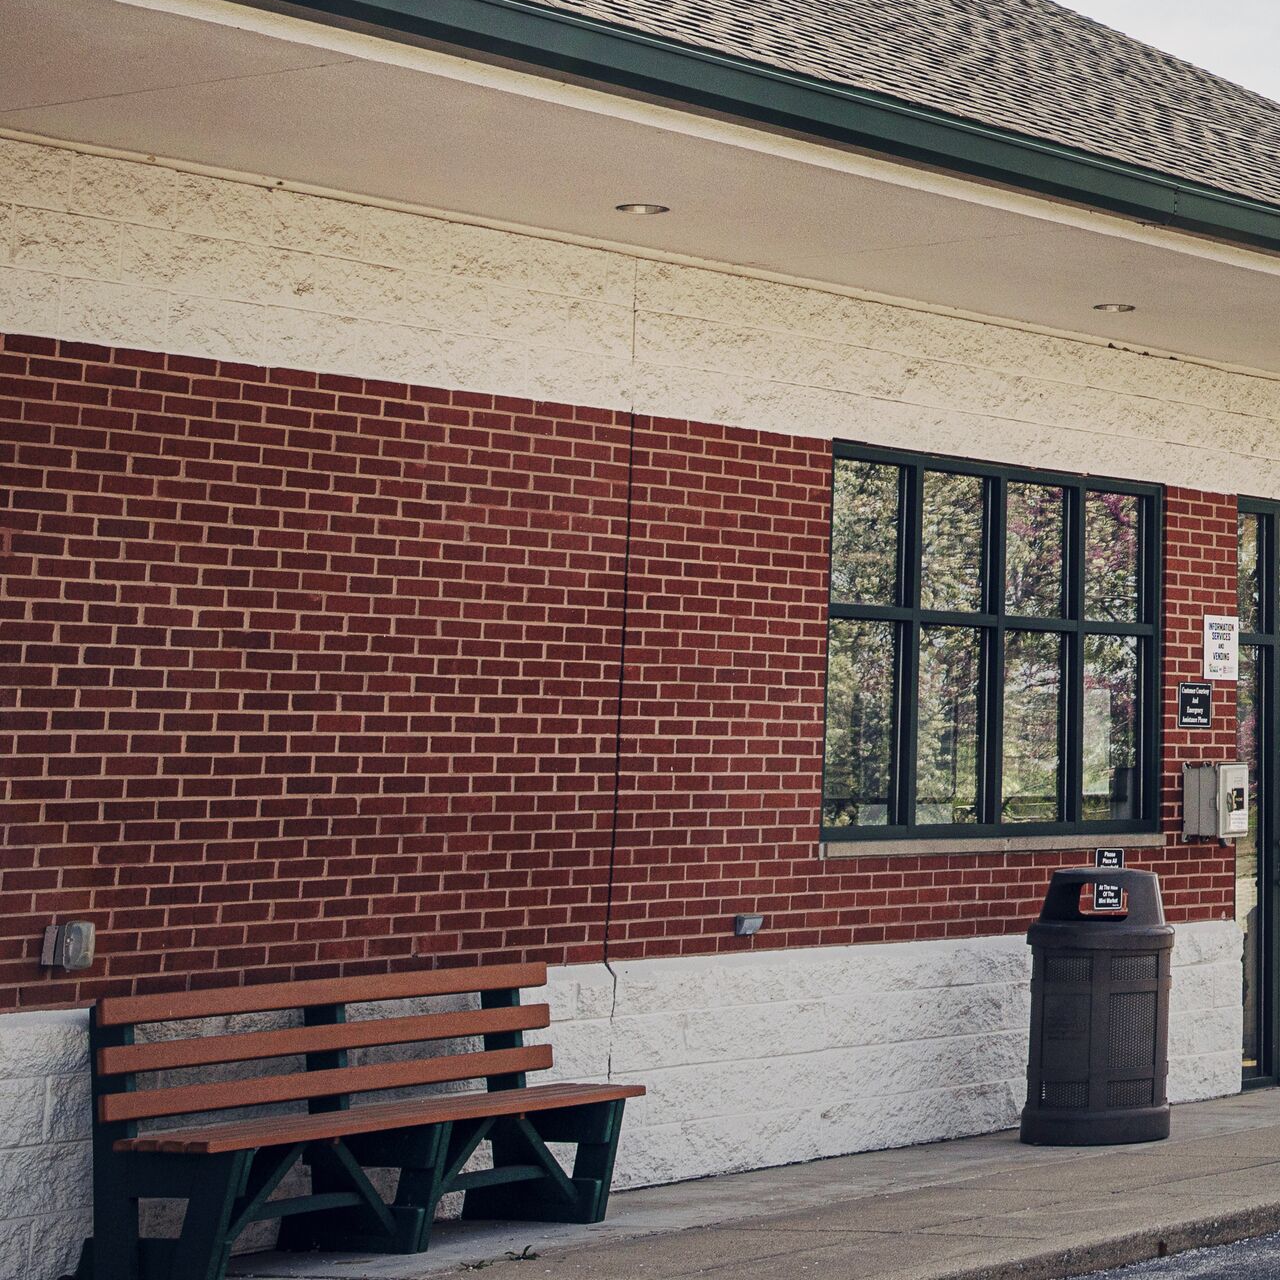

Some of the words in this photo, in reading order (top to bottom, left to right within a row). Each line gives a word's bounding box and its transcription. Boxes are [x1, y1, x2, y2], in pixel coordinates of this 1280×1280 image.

[1208, 622, 1235, 631] INFORMATION
[1211, 632, 1231, 641] SERVICES
[1212, 651, 1230, 661] VENDING
